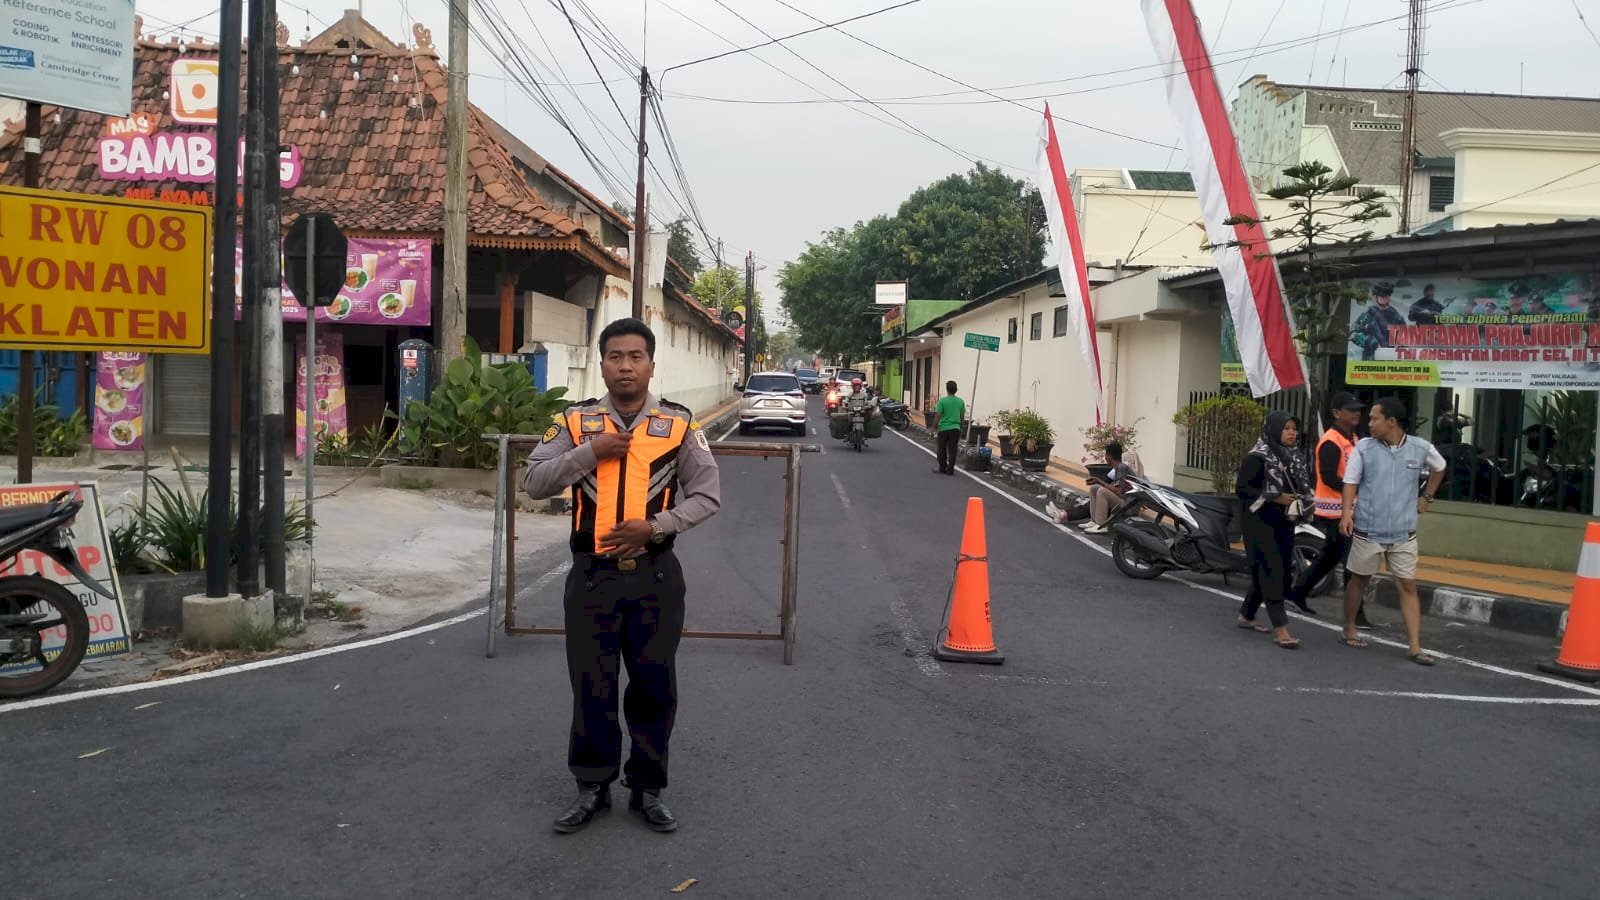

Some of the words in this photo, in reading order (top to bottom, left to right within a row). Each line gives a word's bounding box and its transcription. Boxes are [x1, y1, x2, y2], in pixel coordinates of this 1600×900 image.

[3, 0, 72, 19] Reference
[74, 10, 117, 30] School
[12, 18, 50, 33] CODING
[12, 28, 19, 36] &
[20, 29, 60, 44] ROBOTIK
[71, 31, 123, 49] MONTESSORI
[71, 40, 122, 57] ENRICHMENT
[41, 61, 90, 77] Cambridge
[92, 71, 120, 83] Center
[110, 117, 149, 136] MAS
[126, 187, 155, 201] MIE
[160, 189, 209, 206] AYAM
[29, 203, 109, 246] RW
[127, 213, 187, 252] 08
[0, 303, 187, 340] KLATEN
[1511, 312, 1587, 324] Penerimaan
[1387, 324, 1480, 347] TAMTAMA
[1485, 323, 1584, 347] PRAJURIT
[1396, 348, 1416, 361] TNI
[1419, 348, 1489, 362] ANGKATAN
[1492, 349, 1540, 362] DARAT
